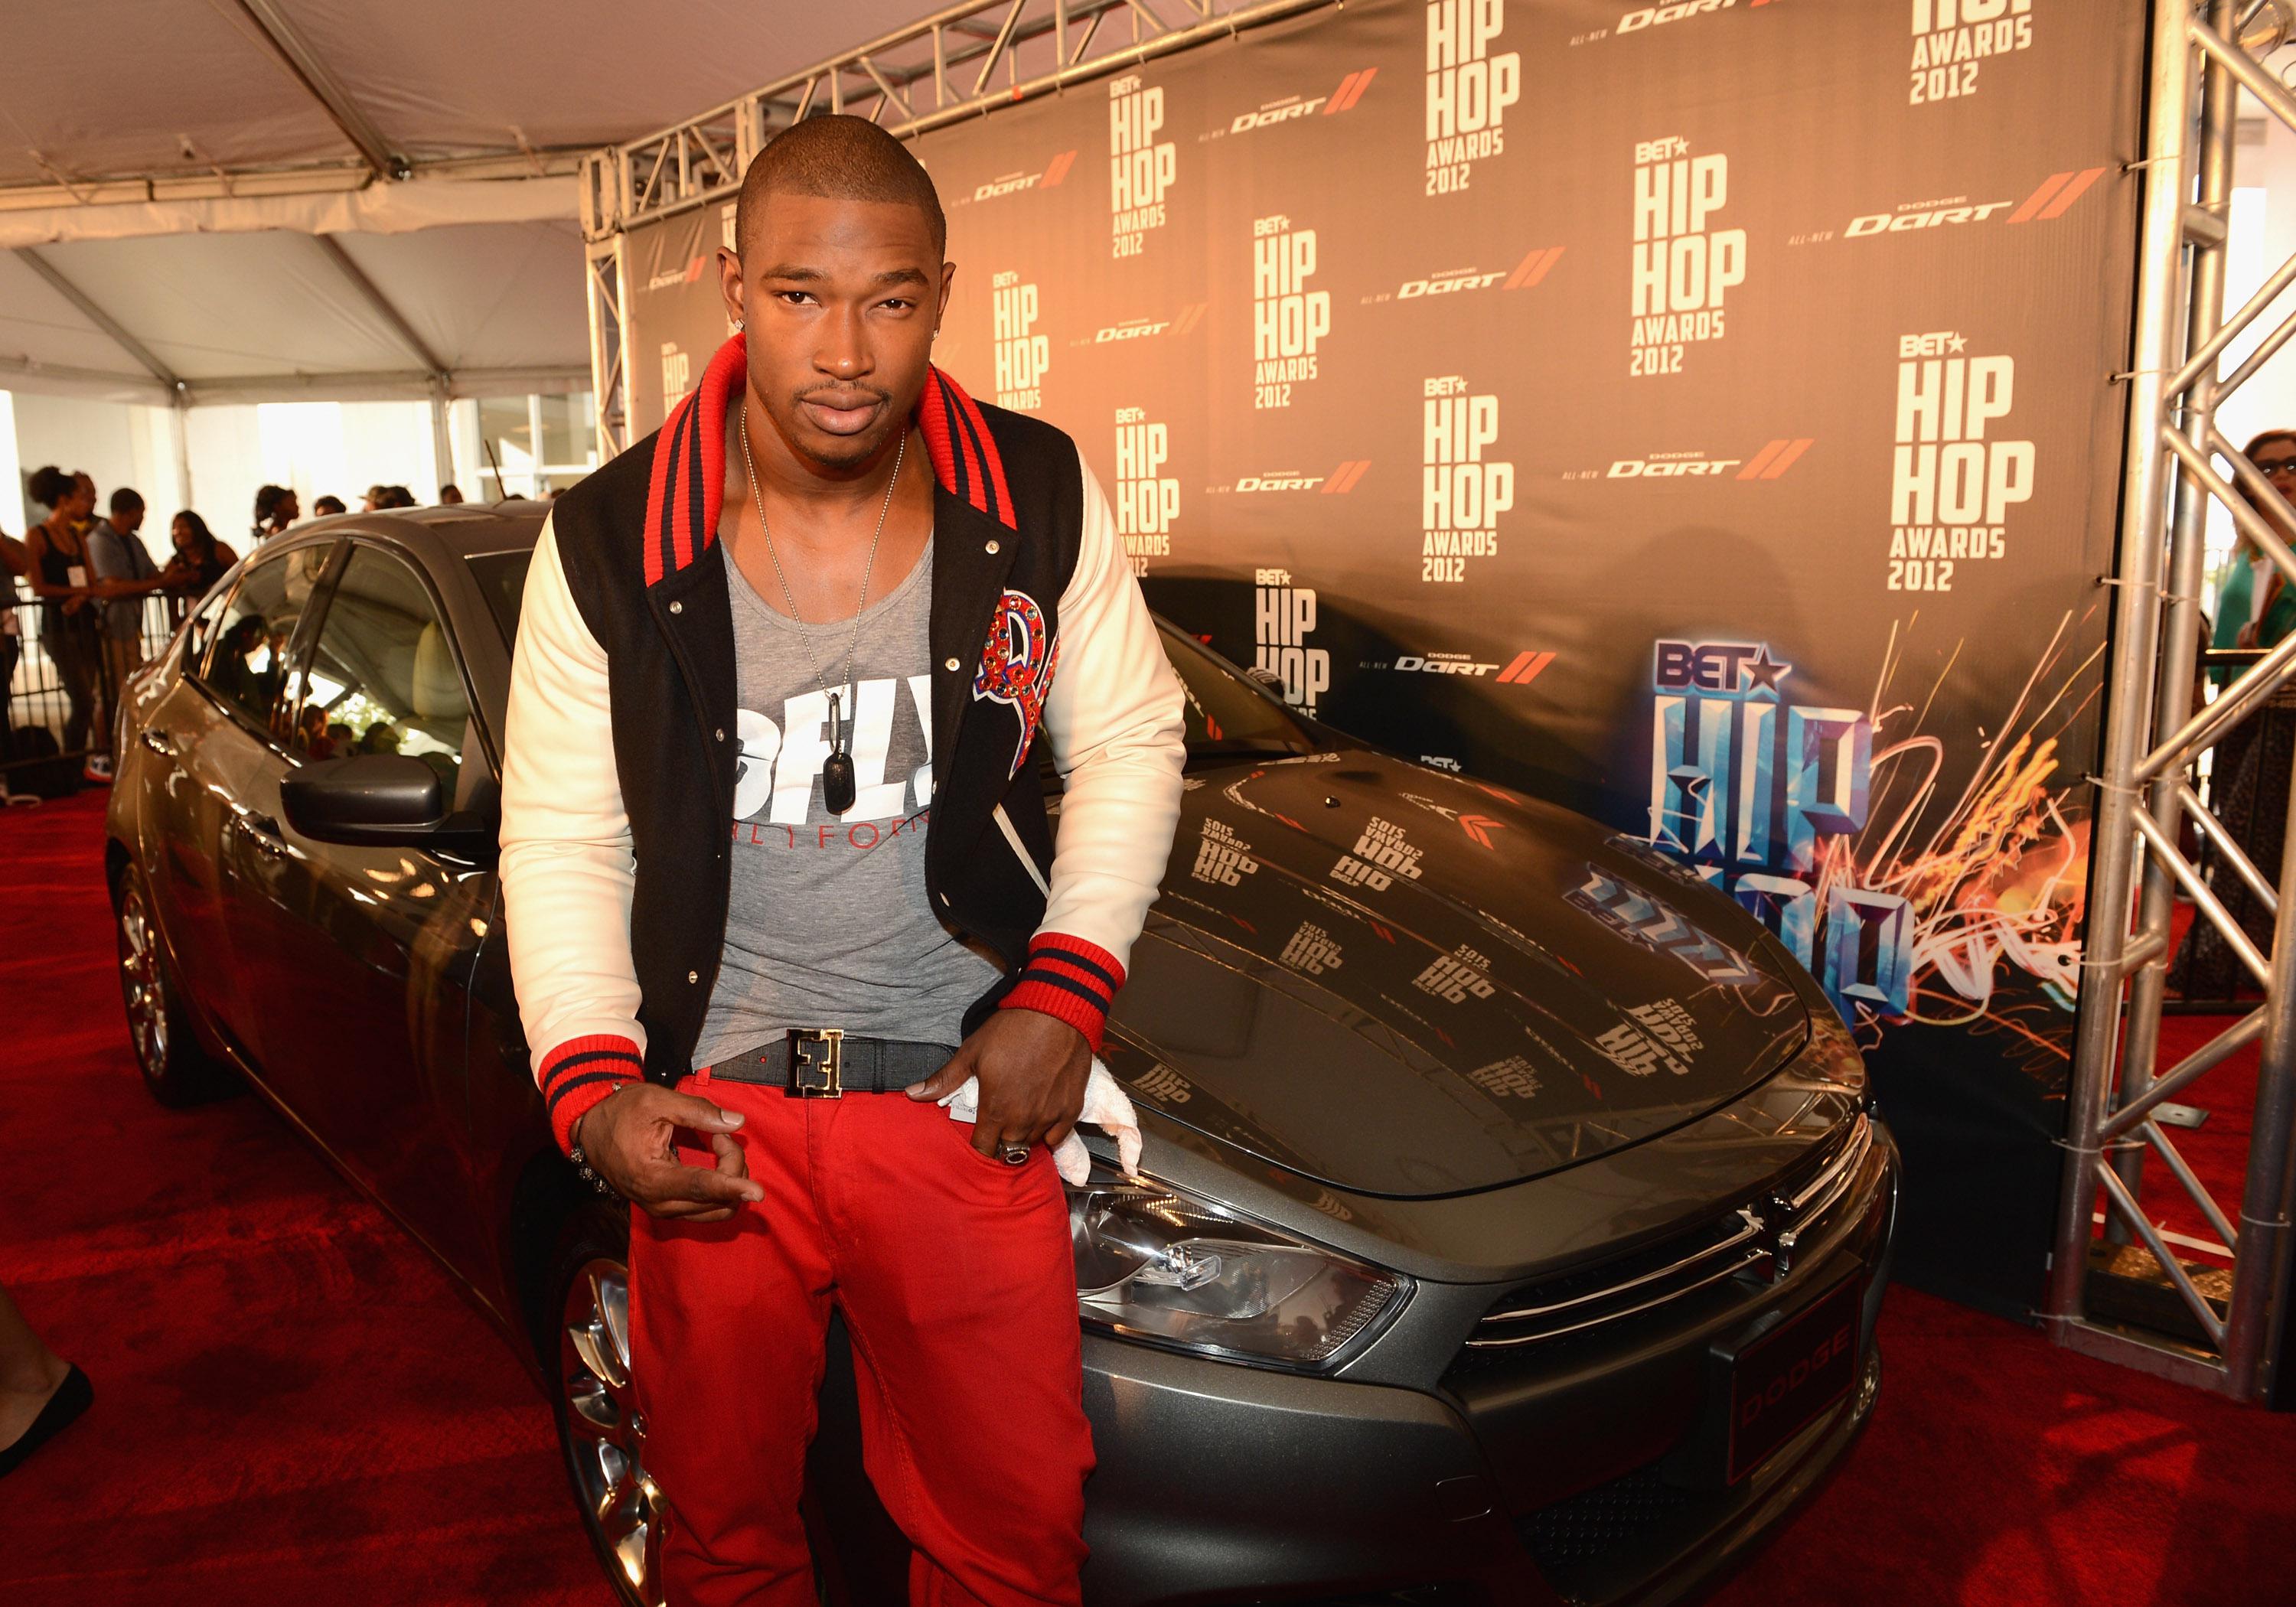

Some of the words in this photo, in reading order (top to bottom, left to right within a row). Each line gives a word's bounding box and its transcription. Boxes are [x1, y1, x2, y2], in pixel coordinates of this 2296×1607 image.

[1427, 0, 1504, 72] HIP
[1910, 14, 2033, 70] AWARDS
[1109, 77, 1133, 98] BET
[1426, 52, 1521, 141] HOP
[1910, 61, 1979, 105] 2012
[1110, 86, 1164, 156] HIP
[1426, 127, 1504, 169] AWARDS
[1635, 137, 1676, 165] BET
[1111, 142, 1176, 214] HOP
[1426, 163, 1470, 197] 2012
[1633, 153, 1728, 242] HIP
[1897, 195, 1967, 213] DODGE
[1112, 204, 1166, 236] AWARDS
[1254, 215, 1283, 236] BET
[1112, 232, 1143, 259] 2012
[1788, 231, 1835, 246] ALL-NEW
[993, 271, 1011, 289] BET
[1254, 230, 1316, 300] HIP
[1631, 229, 1747, 318] HOP
[993, 284, 1039, 341] HIP
[1254, 291, 1330, 360] HOP
[1631, 310, 1725, 347] AWARDS
[1630, 344, 1684, 376] 2012
[1899, 332, 1947, 358] BET
[995, 334, 1049, 393] HOP
[1254, 357, 1318, 385] AWARDS
[1255, 384, 1291, 409] 2012
[1424, 376, 1458, 396] BET
[1895, 355, 2014, 443] HIP
[1115, 407, 1139, 425] BET
[1424, 395, 1499, 464] HIP
[1116, 422, 1168, 480] HIP
[1649, 451, 1704, 460] DODGE
[1561, 470, 1599, 481] ALL-NEW
[1890, 440, 2036, 526] HOP
[1117, 478, 1180, 534] HOP
[1422, 462, 1515, 530] HOP
[1120, 534, 1170, 557] WARDS
[1422, 530, 1498, 556] AWARDS
[1888, 527, 2006, 559] AWARDS
[1255, 569, 1285, 586] BET
[1421, 557, 1466, 583] 2012
[1887, 560, 1955, 592] 2012
[1255, 588, 1317, 647] HIP
[1427, 652, 1473, 660] DODGE
[1655, 641, 1759, 692] BET
[1649, 695, 1874, 873] HIP
[1740, 1324, 1851, 1429] DODGE
